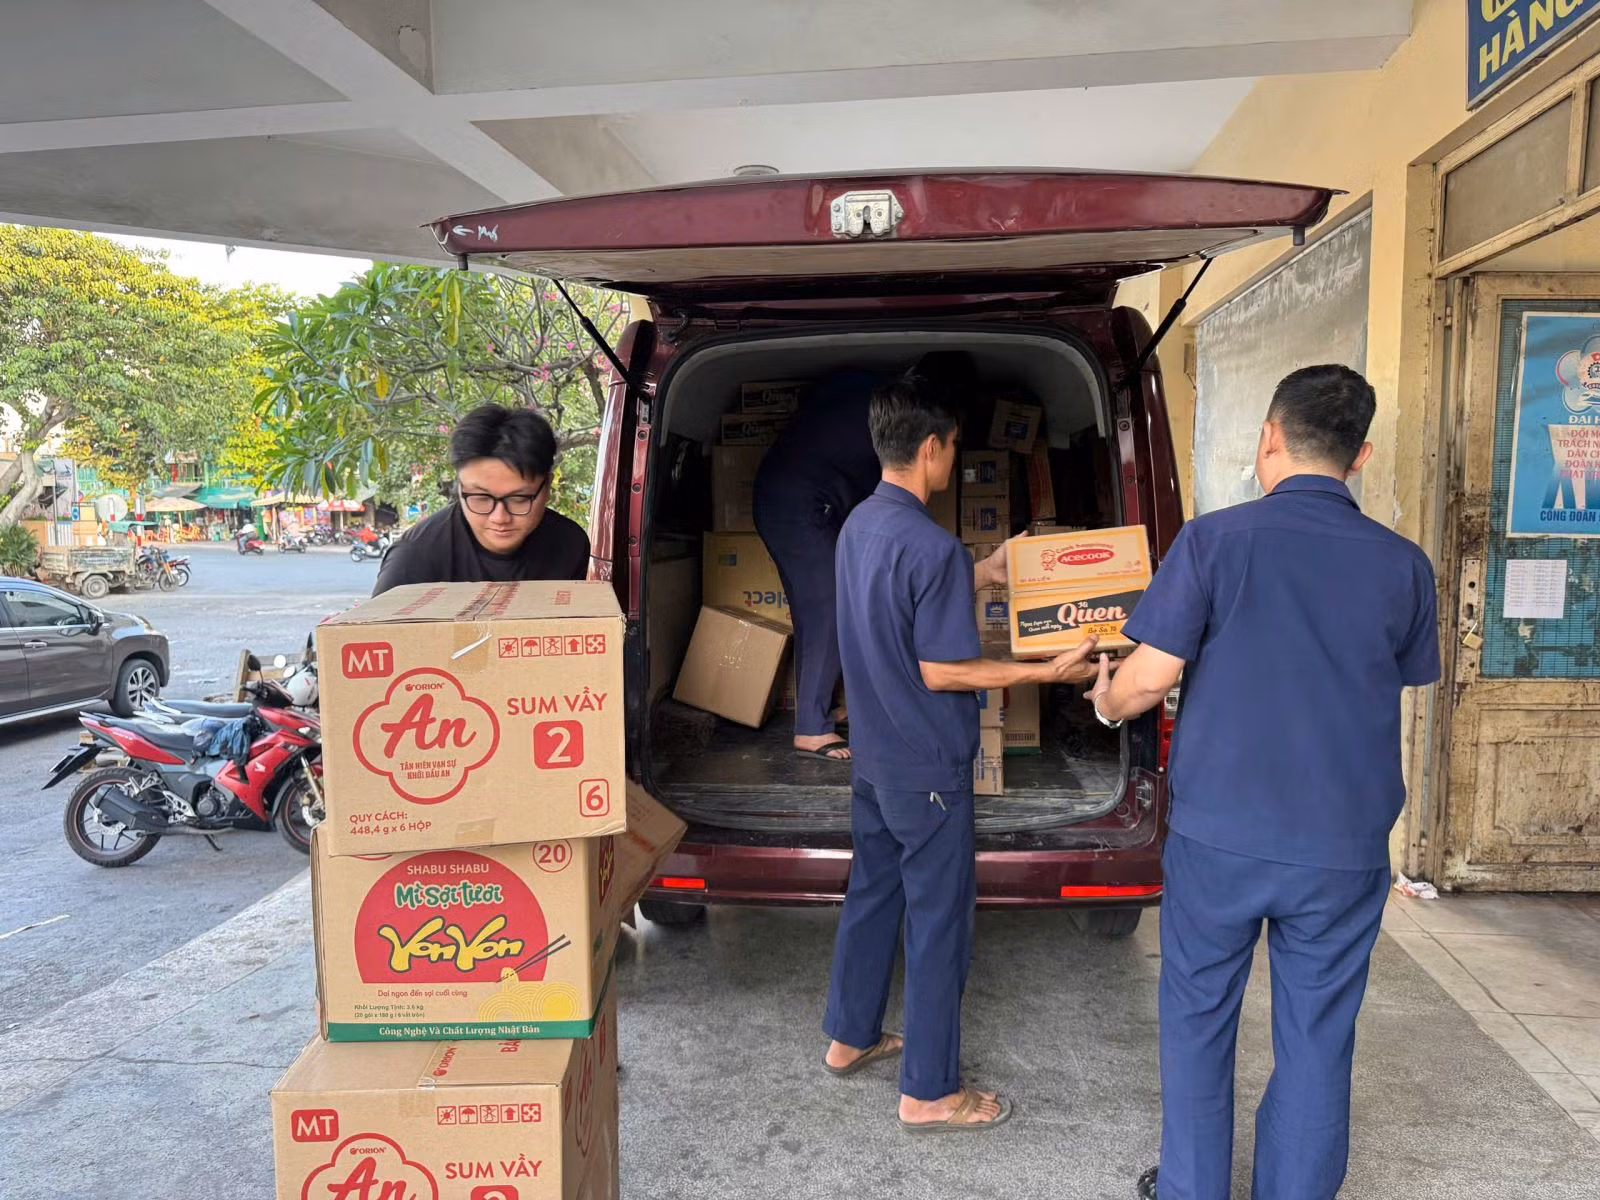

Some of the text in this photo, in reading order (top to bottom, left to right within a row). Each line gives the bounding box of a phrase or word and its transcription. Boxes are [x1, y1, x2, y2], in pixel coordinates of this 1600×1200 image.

[1057, 603, 1128, 626] Quen
[347, 649, 388, 672] MT
[415, 683, 443, 691] ORION
[507, 696, 558, 715] SUM
[380, 693, 477, 758] An
[546, 727, 571, 764] 2
[585, 785, 603, 811] 6
[350, 810, 407, 824] QUY CÁCH:
[350, 824, 381, 836] 448,4
[383, 826, 389, 835] g
[400, 823, 406, 831] 6
[408, 820, 432, 832] HỘP
[538, 844, 566, 864] 20
[407, 862, 490, 876] SHABU SHABU
[378, 989, 390, 998] Dai
[379, 1024, 540, 1037] Công Nghệ Và Chất Lượng Nhật Bản
[296, 1115, 335, 1136] MT
[359, 1147, 385, 1155] ORION
[445, 1161, 494, 1180] SUM
